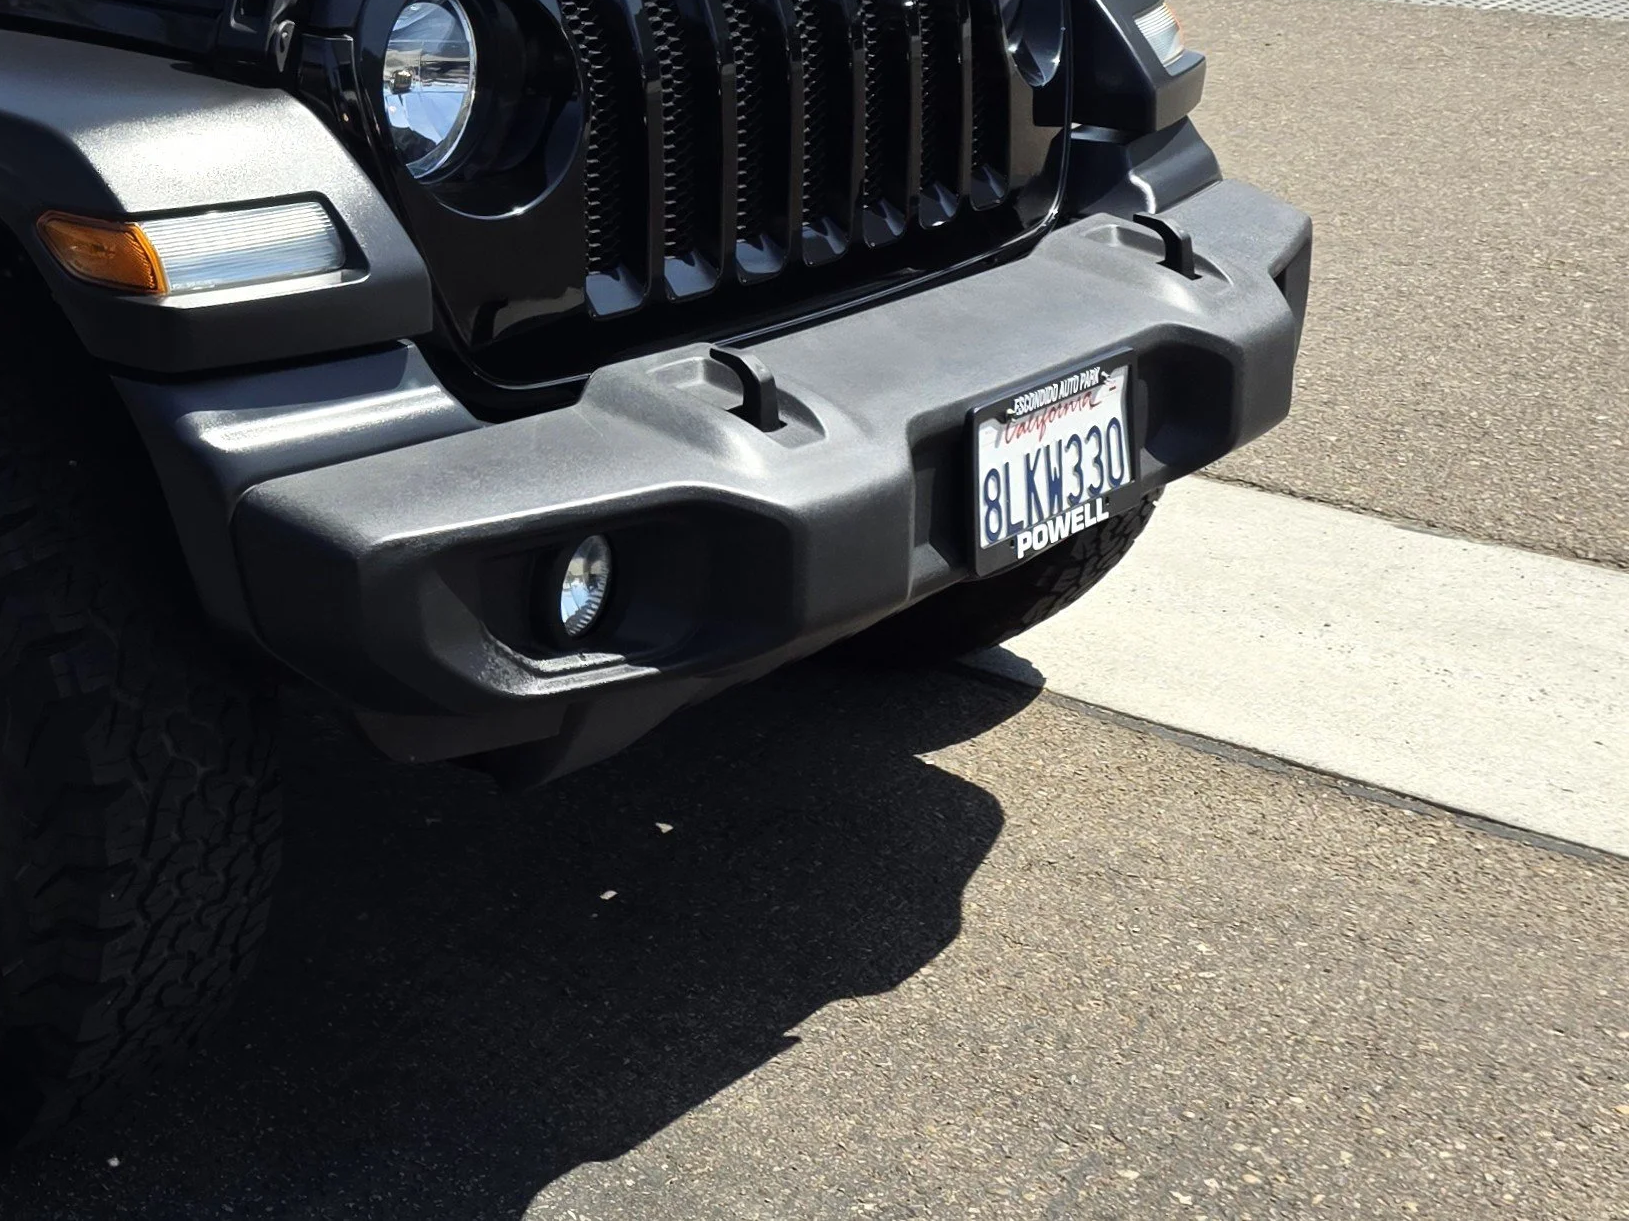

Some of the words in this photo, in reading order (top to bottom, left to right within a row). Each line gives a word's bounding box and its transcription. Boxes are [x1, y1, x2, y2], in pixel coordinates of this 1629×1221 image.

[1004, 391, 1102, 444] California
[1013, 383, 1059, 416] ESCONDIDO
[1058, 374, 1080, 400] AUTO
[1079, 366, 1101, 391] PARK
[982, 416, 1125, 543] 8LKW330
[1017, 497, 1110, 559] POWELL
